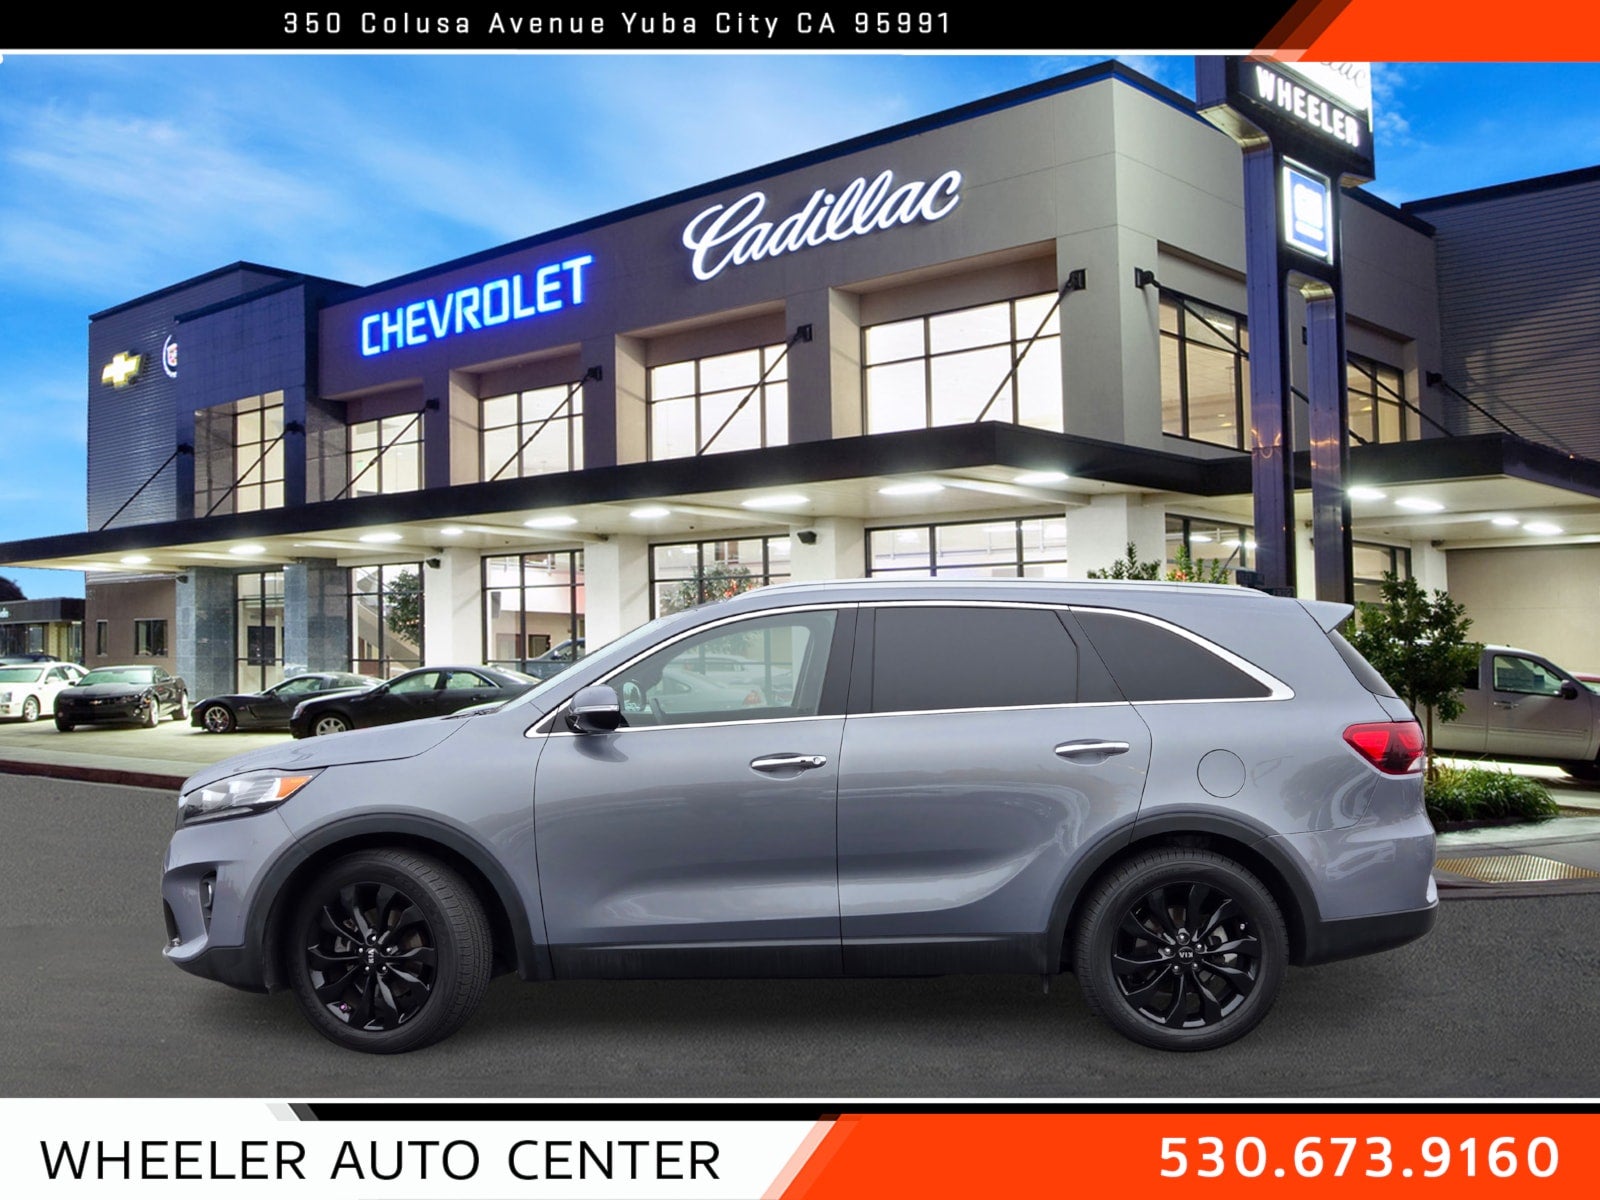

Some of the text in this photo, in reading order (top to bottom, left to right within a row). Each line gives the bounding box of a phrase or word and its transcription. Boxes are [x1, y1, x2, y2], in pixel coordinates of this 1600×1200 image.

[1255, 65, 1359, 147] WHEELER
[682, 169, 962, 281] Cadillac
[361, 254, 593, 357] CHEVROLET
